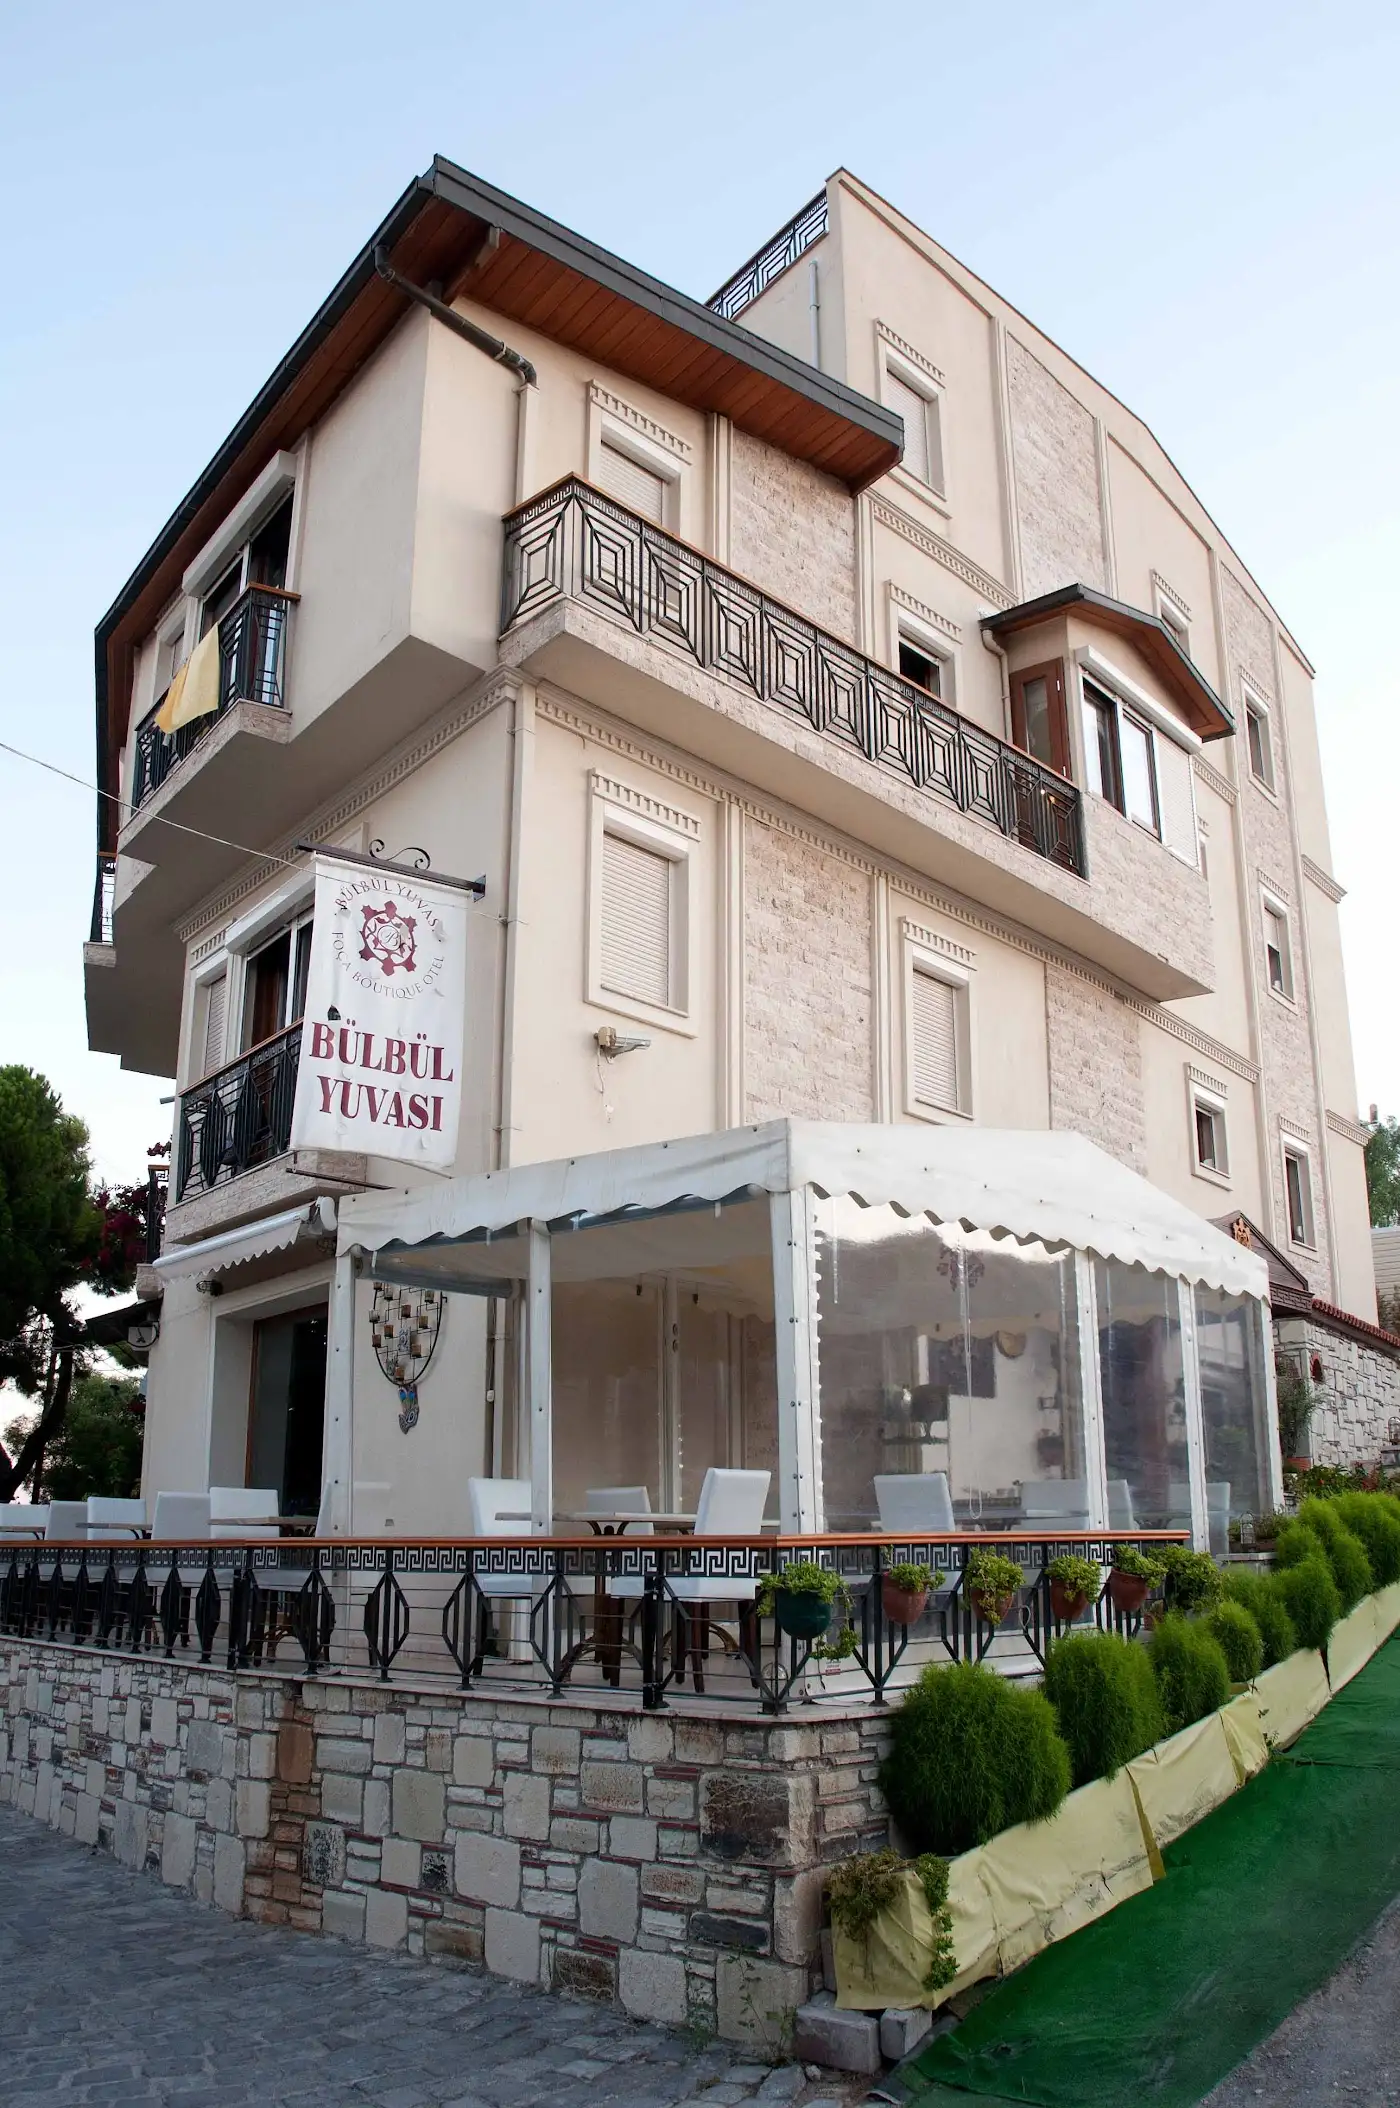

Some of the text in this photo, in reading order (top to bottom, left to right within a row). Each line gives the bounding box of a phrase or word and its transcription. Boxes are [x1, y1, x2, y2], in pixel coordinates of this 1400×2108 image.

[335, 877, 442, 933] BÜLBÜL YUVAS
[332, 932, 445, 1000] FOÇA BOUTIQUE OTEL
[309, 1018, 454, 1082] BÜLBÜL
[316, 1075, 444, 1132] YUVASI
